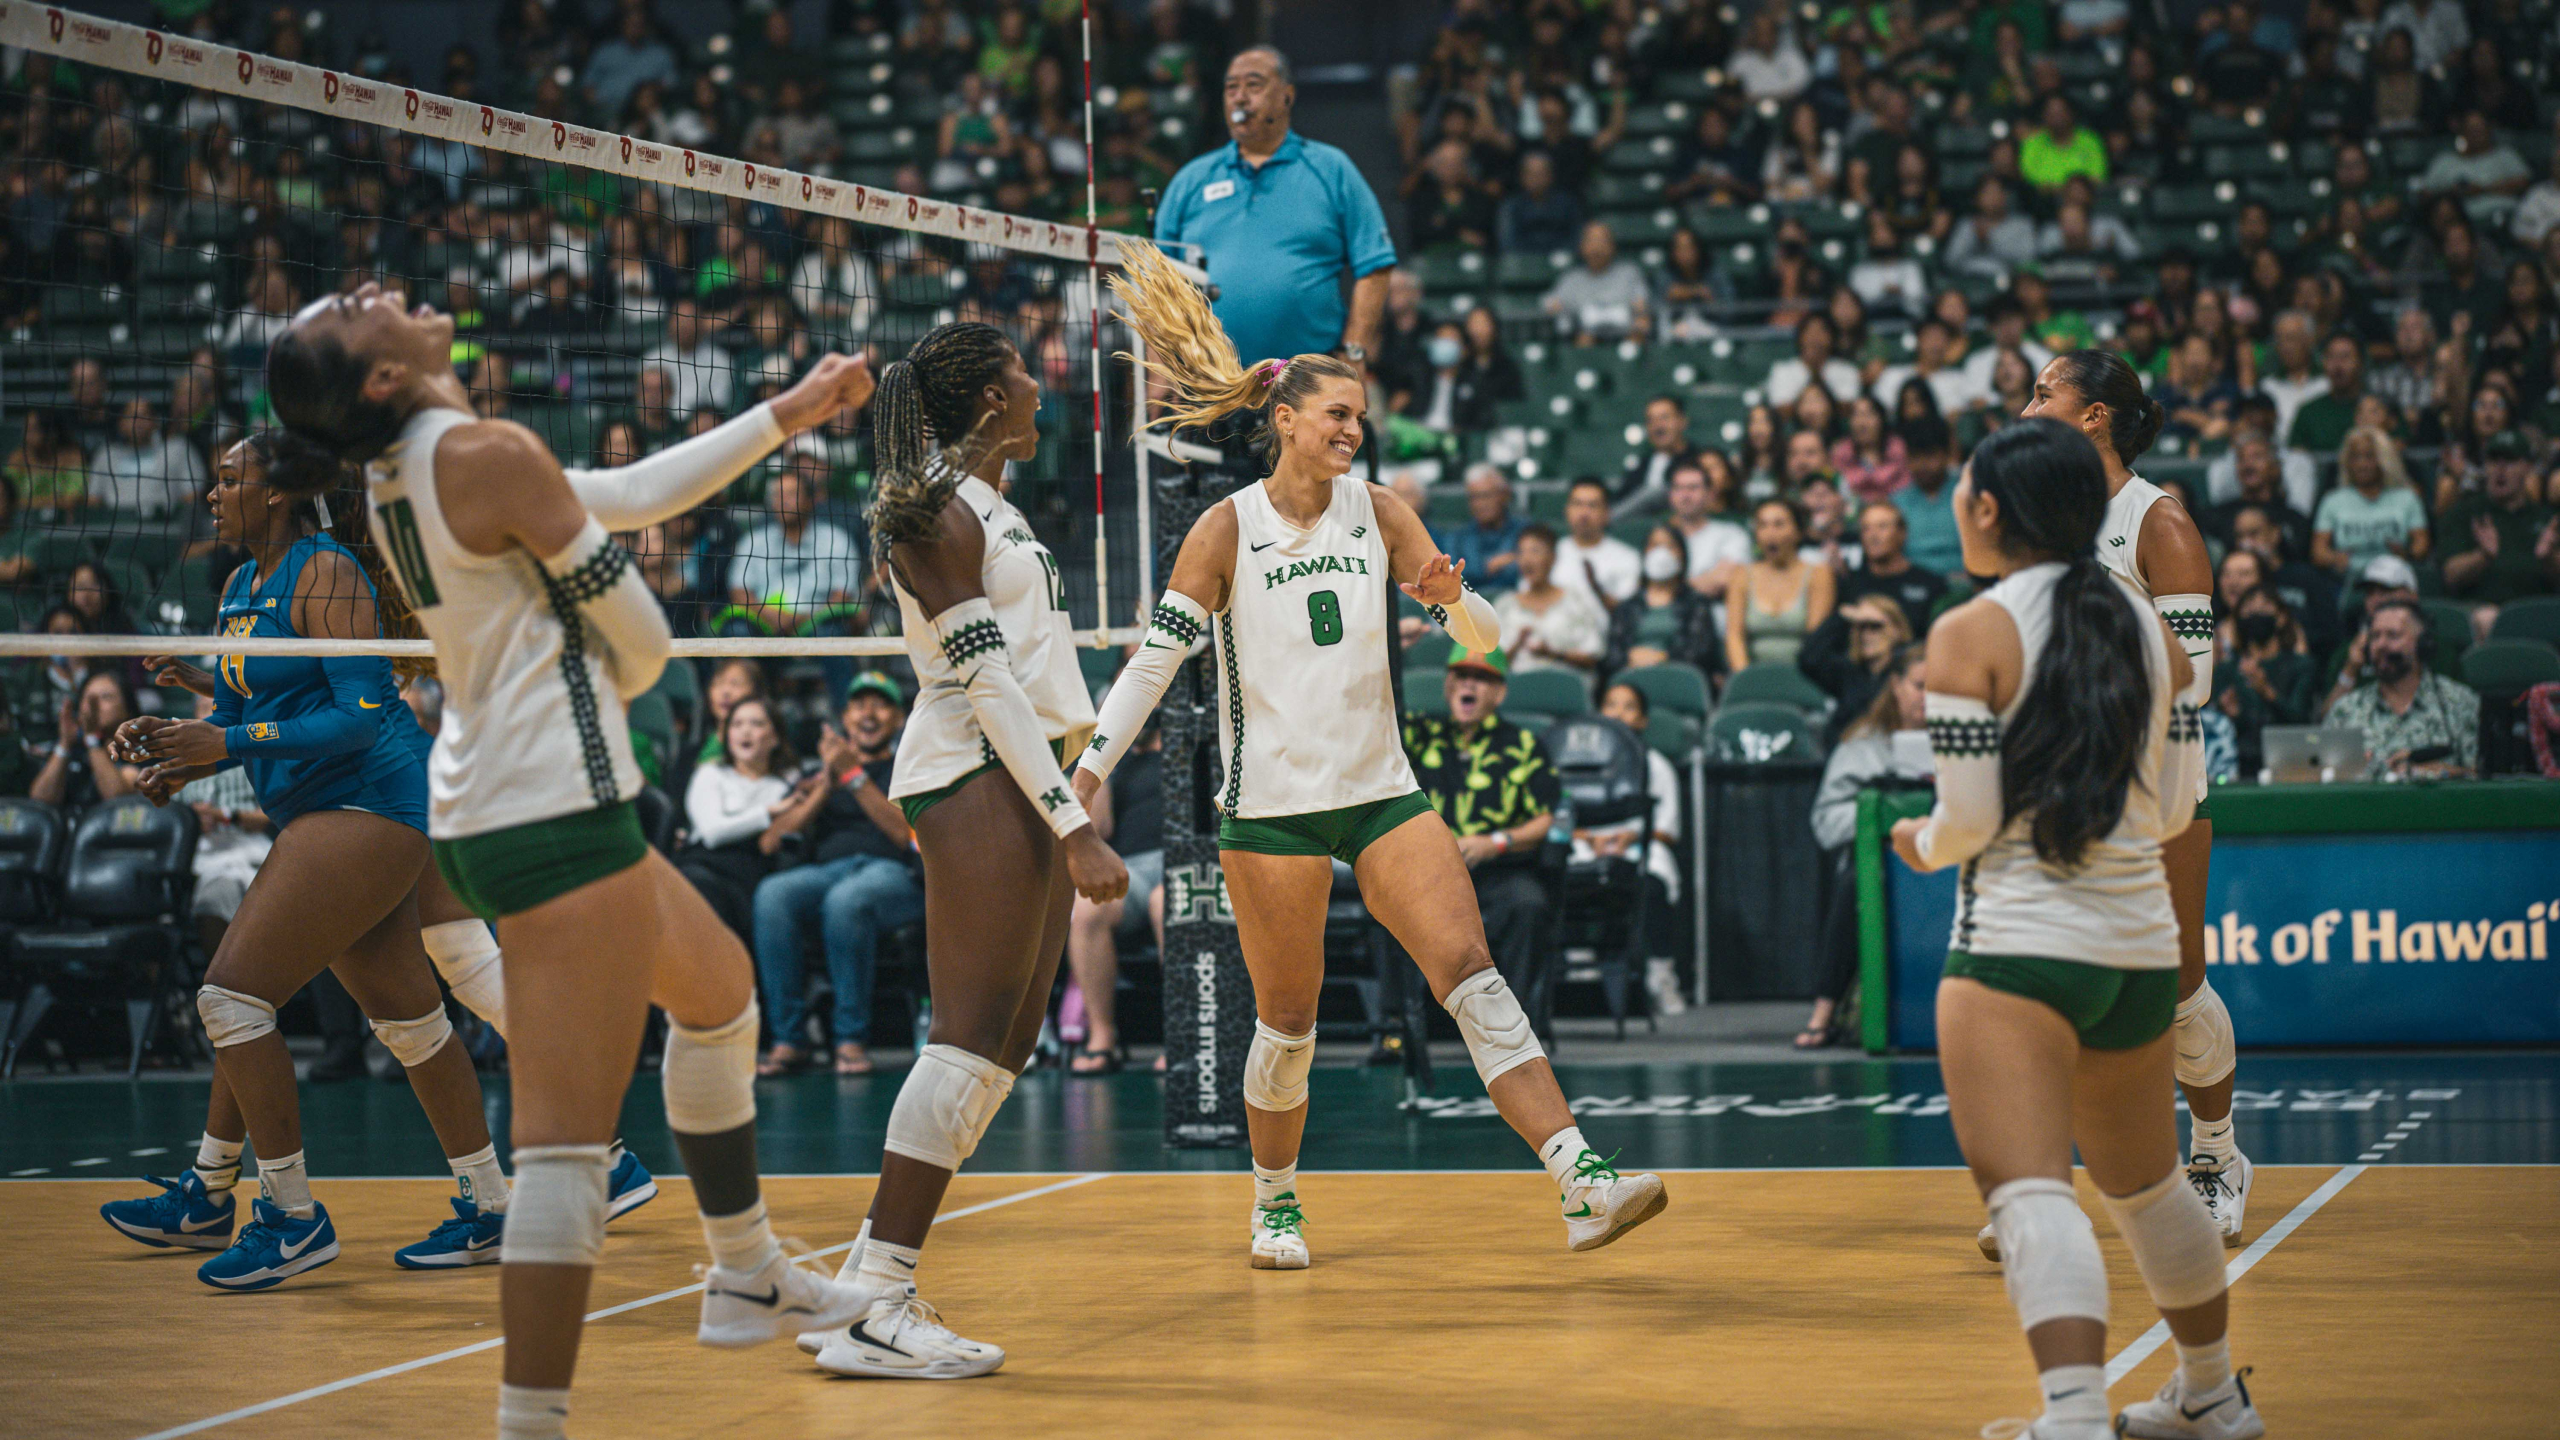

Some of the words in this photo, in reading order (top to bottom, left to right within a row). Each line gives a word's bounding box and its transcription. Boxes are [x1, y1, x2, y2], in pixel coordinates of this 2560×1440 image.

[377, 497, 442, 609] 10
[1307, 589, 1344, 646] 8
[1039, 786, 1071, 813] H
[1166, 861, 1237, 926] H
[2271, 908, 2342, 966] of
[2350, 899, 2560, 963] Hawai'
[1194, 951, 1219, 1024] sports
[1195, 1026, 1219, 1114] imports
